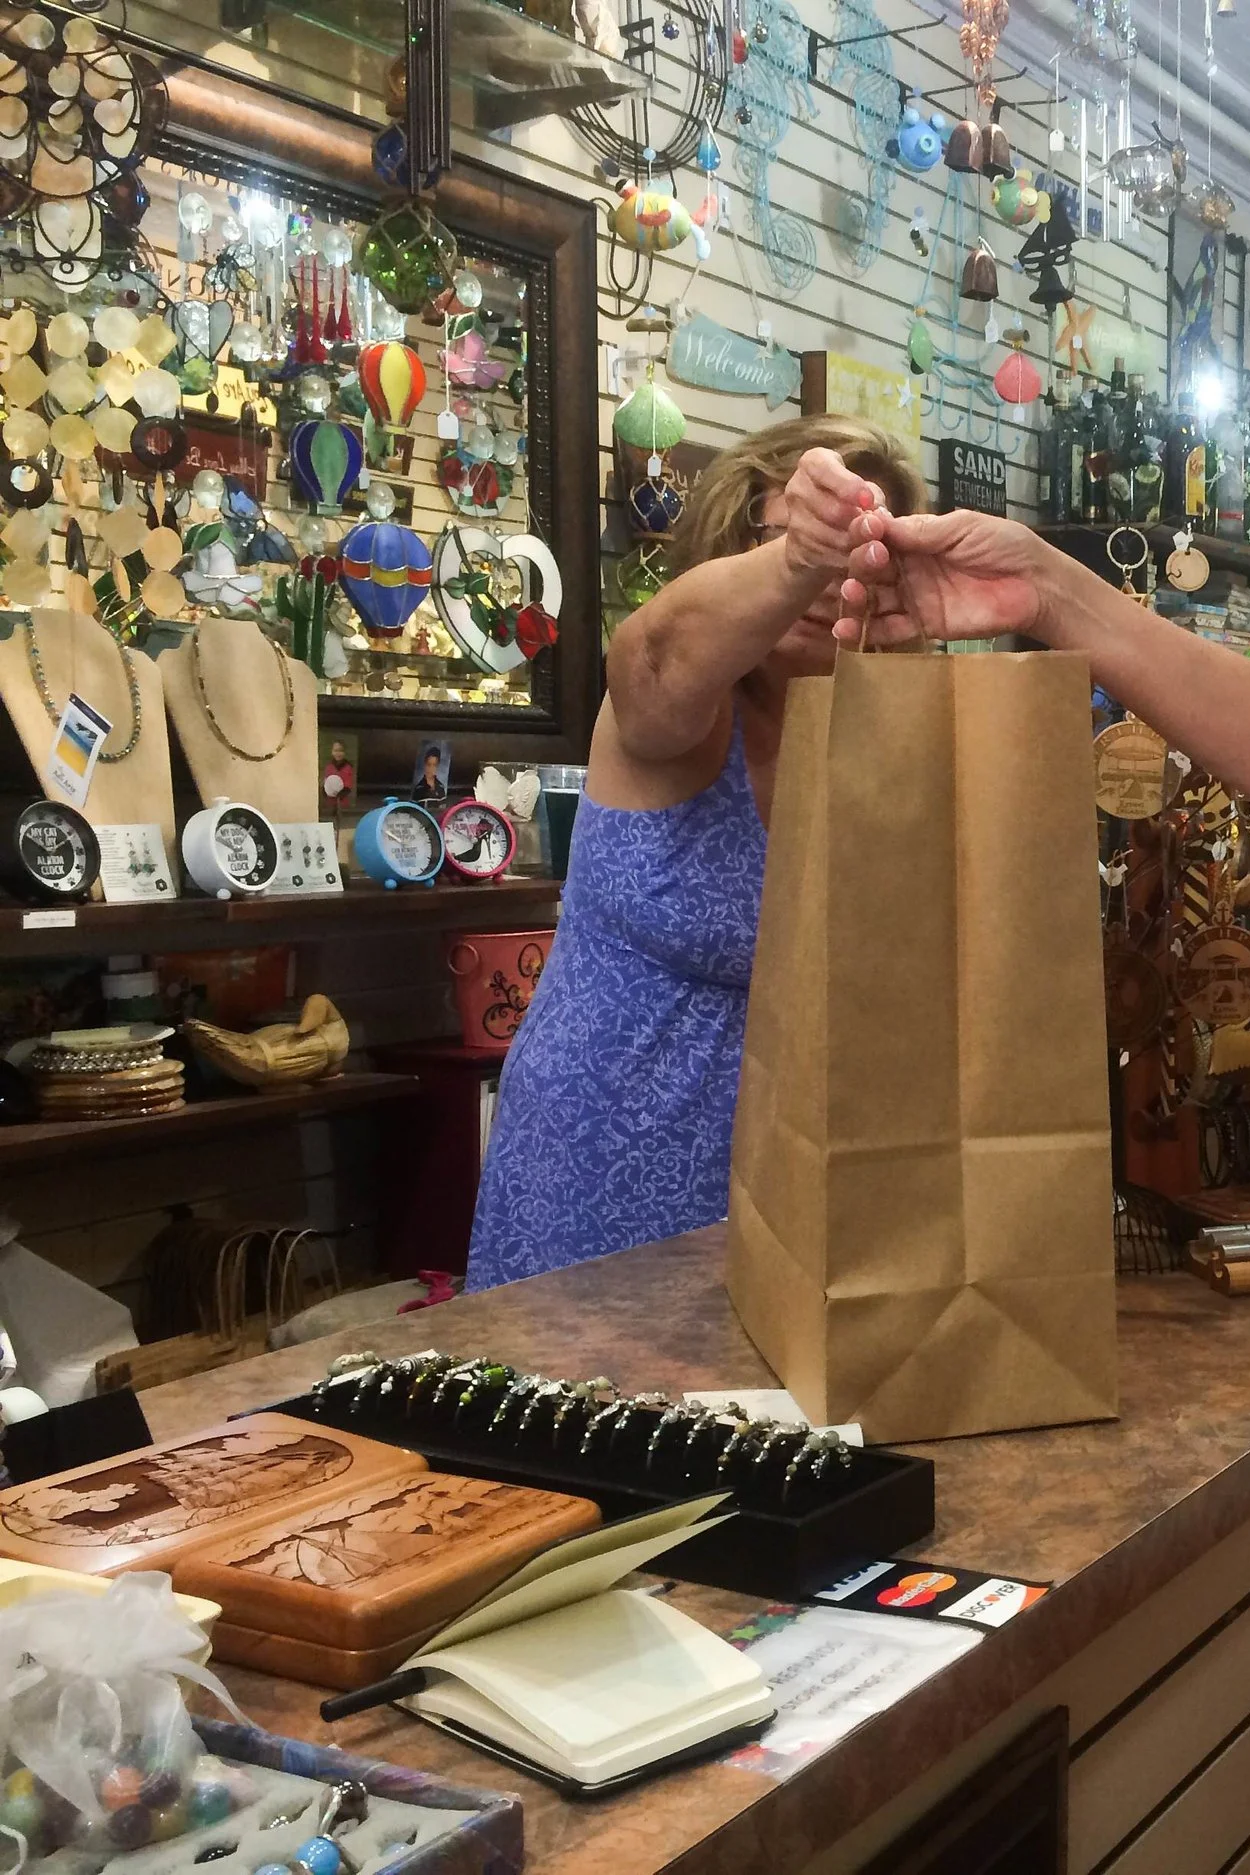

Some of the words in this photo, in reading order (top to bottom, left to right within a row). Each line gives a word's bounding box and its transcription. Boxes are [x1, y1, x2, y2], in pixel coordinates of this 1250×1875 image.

[685, 331, 775, 385] Welcome
[954, 446, 1005, 485] SAND
[953, 478, 992, 509] BETWEEN
[36, 855, 65, 866] ALARM
[40, 864, 66, 876] CLOCK
[230, 861, 250, 872] CLOCK
[958, 1583, 1026, 1619] DISCOVER
